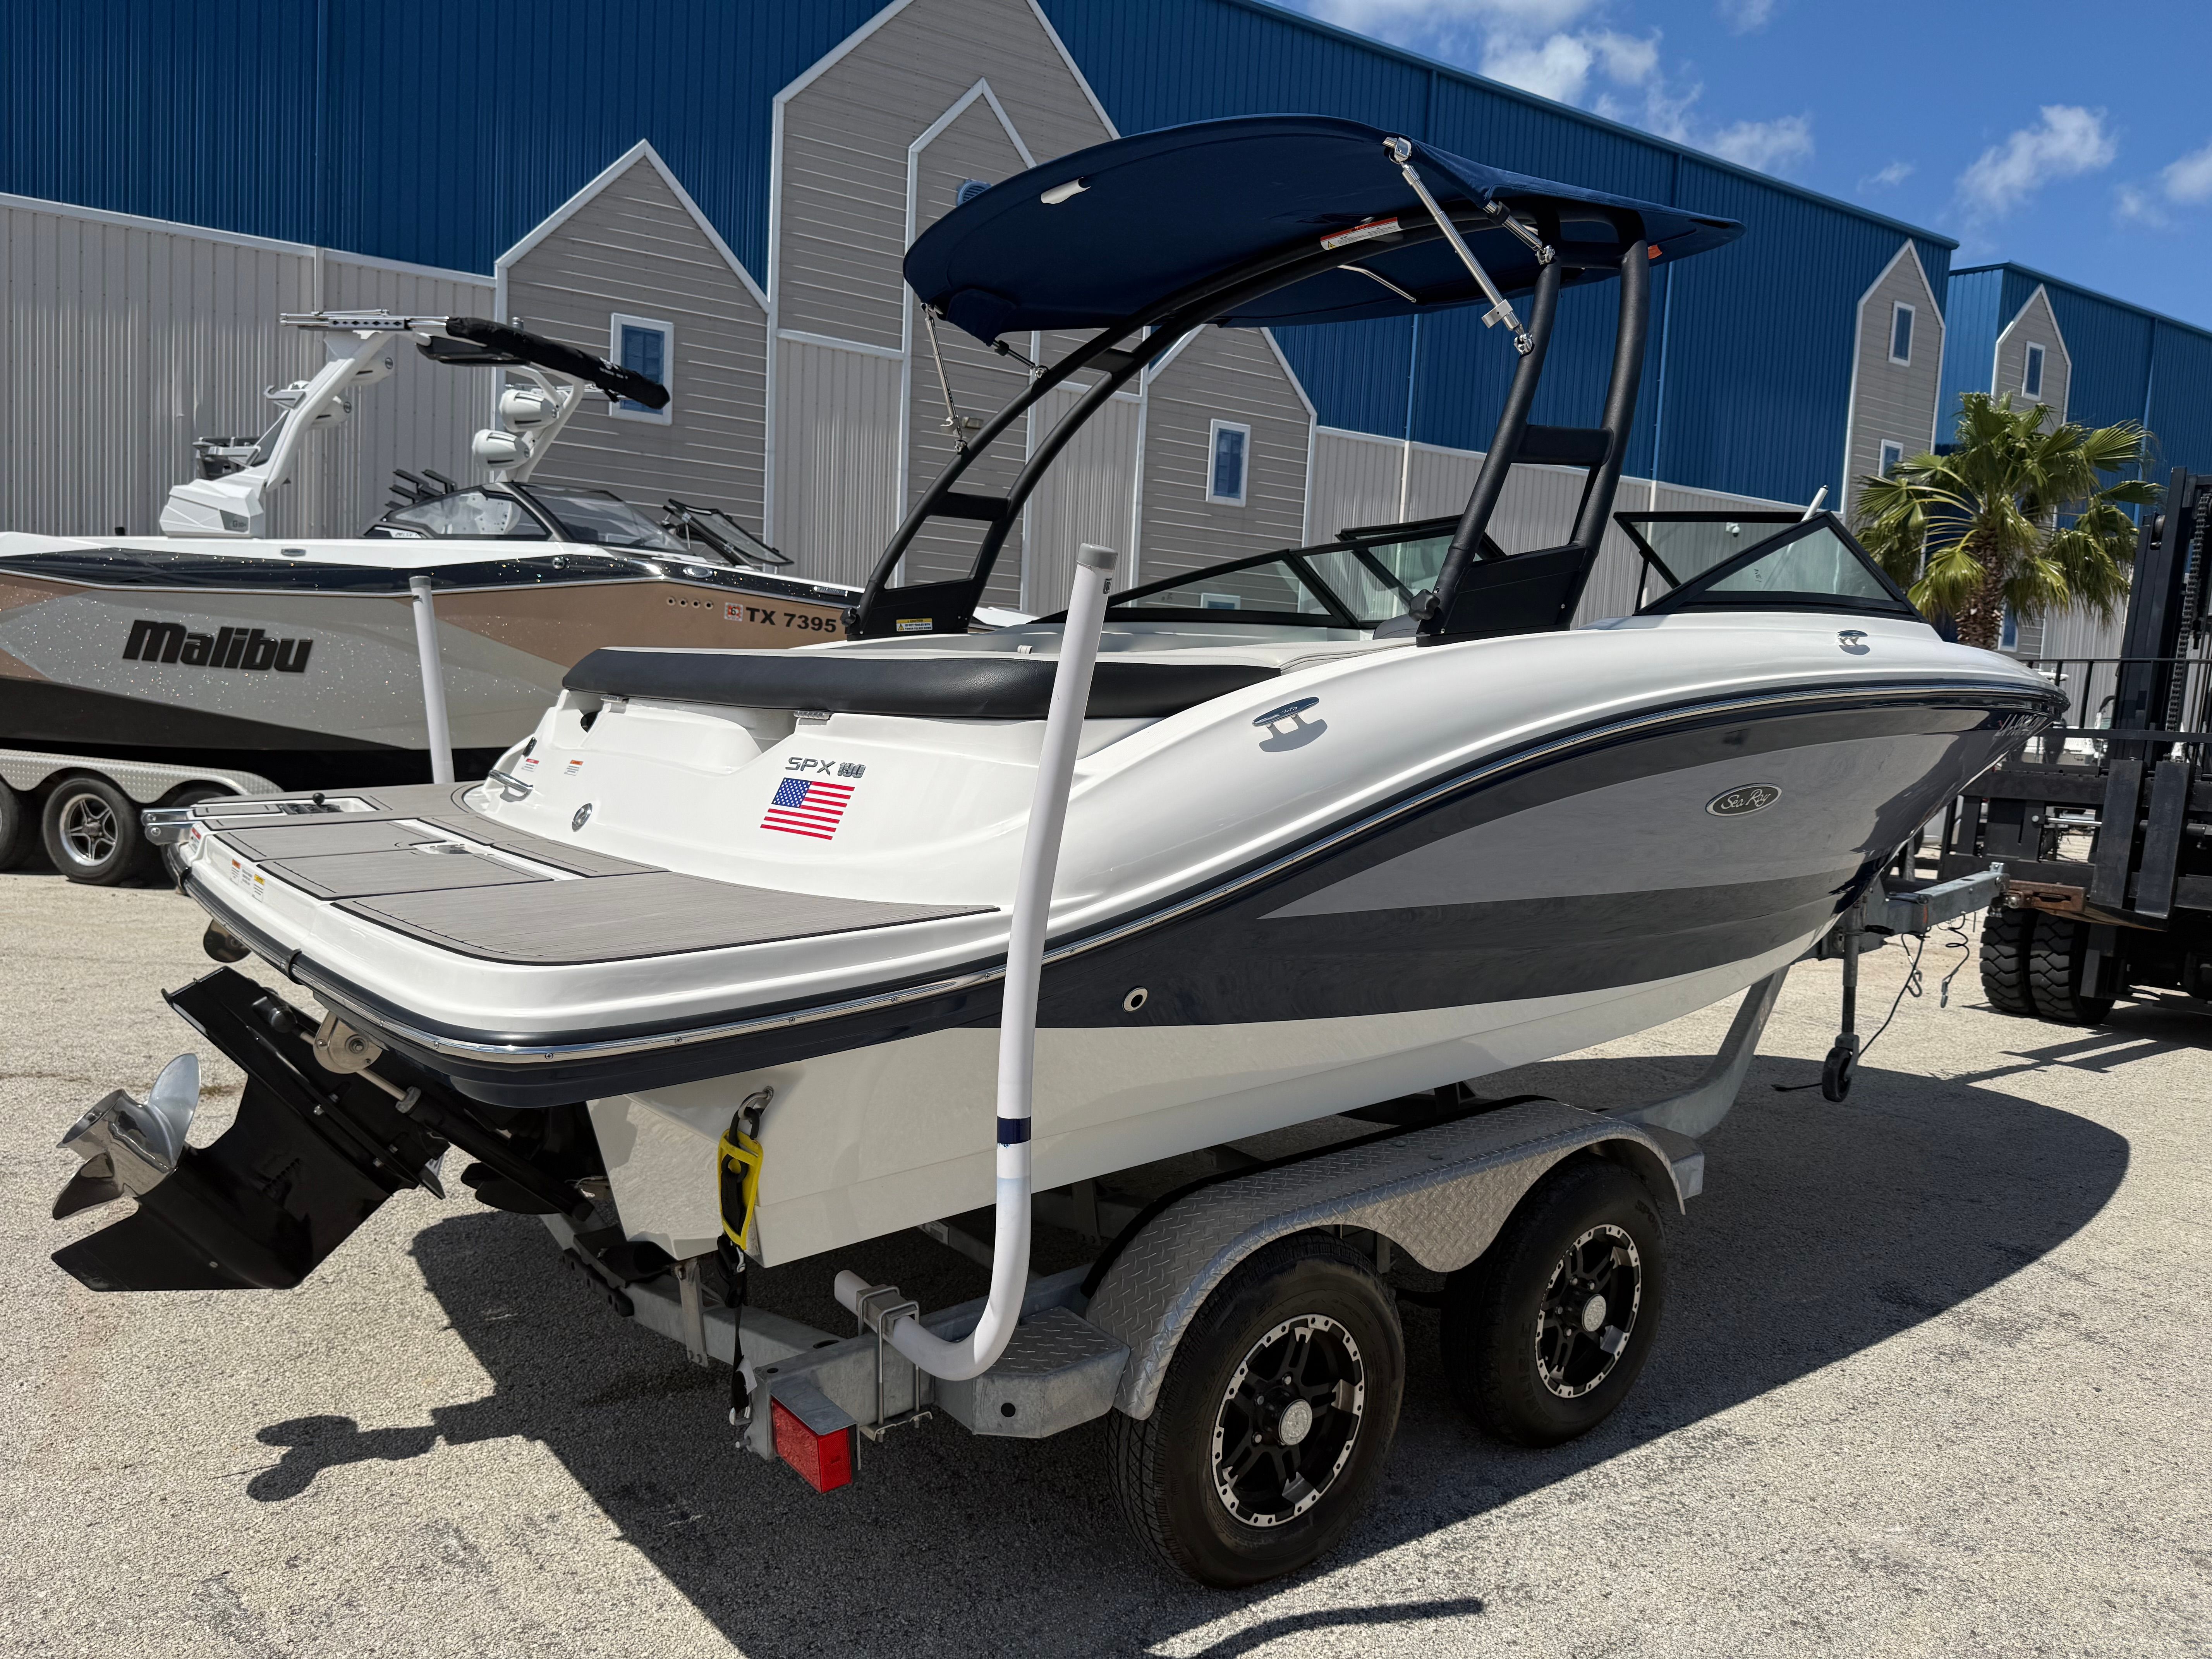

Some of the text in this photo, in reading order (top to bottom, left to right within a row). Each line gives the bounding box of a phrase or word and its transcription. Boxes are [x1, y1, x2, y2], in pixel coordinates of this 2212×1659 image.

[746, 607, 836, 633] TX 7395
[122, 619, 313, 673] Malibu
[785, 757, 866, 778] SPX 190
[1721, 789, 1771, 810] Sea Ray
